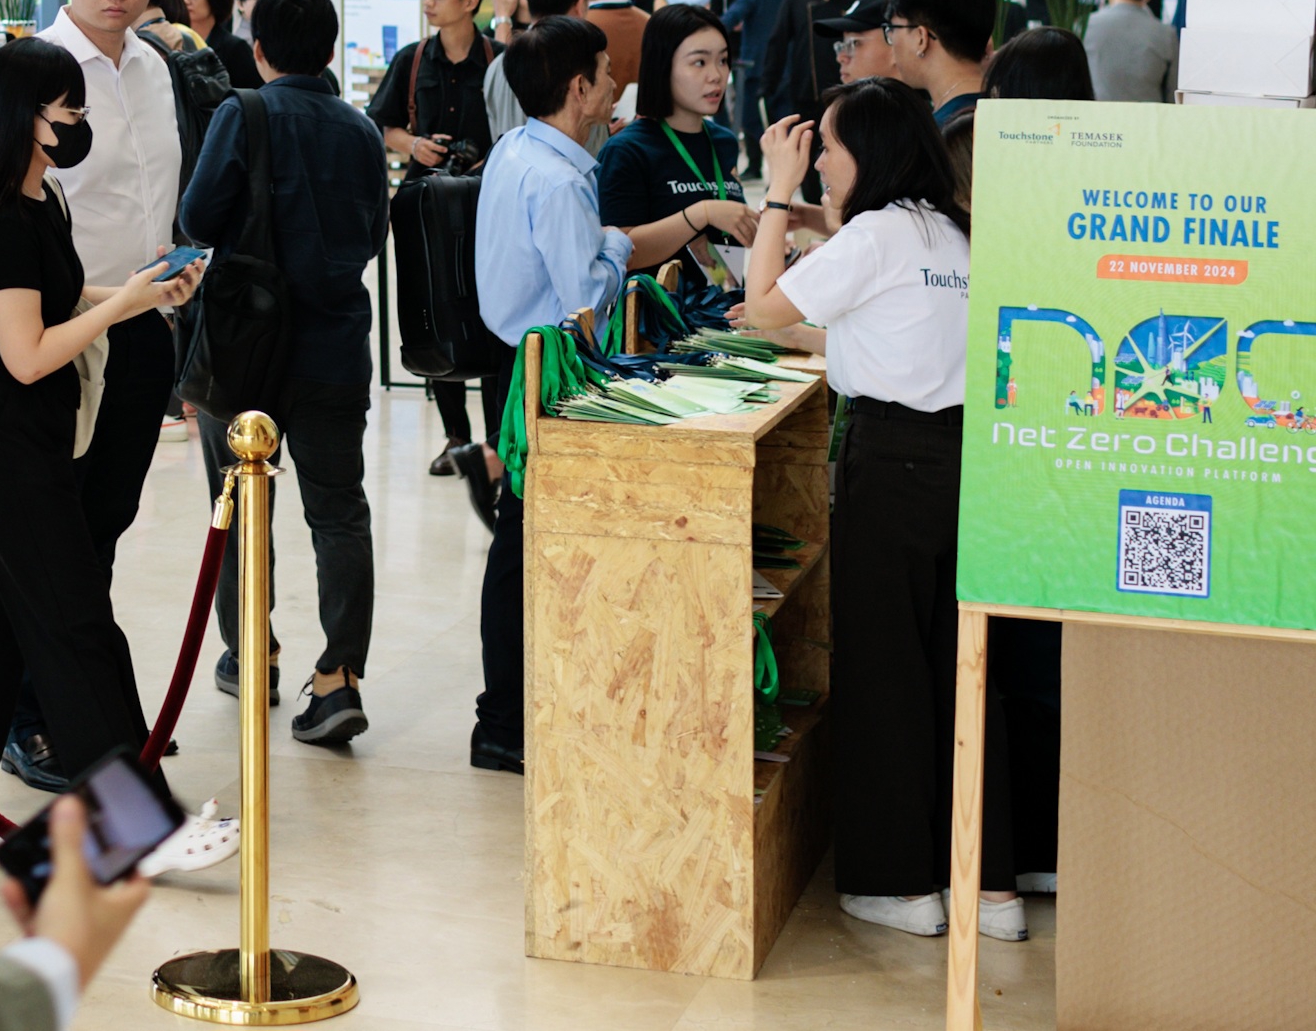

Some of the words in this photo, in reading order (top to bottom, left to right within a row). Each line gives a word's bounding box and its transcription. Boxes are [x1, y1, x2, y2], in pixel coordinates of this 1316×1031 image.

[998, 131, 1054, 142] Touchstone
[1070, 132, 1124, 141] TEMASEK
[1071, 140, 1123, 148] FOUNDATION
[667, 179, 741, 194] Toucsone
[1082, 189, 1179, 210] WELCOME
[1189, 193, 1213, 211] TO
[1224, 195, 1267, 213] OUR
[1067, 212, 1171, 243] GRAND
[1184, 217, 1279, 249] FINALE
[1109, 260, 1124, 273] 22
[1130, 261, 1198, 276] NOVEMBER
[1204, 265, 1236, 278] 2024
[1066, 427, 1156, 455] Zero
[1055, 458, 1092, 471] OPEN
[1101, 461, 1195, 477] INNOVATION
[1204, 468, 1282, 483] PLATFORM
[1145, 495, 1186, 508] AGENDA
